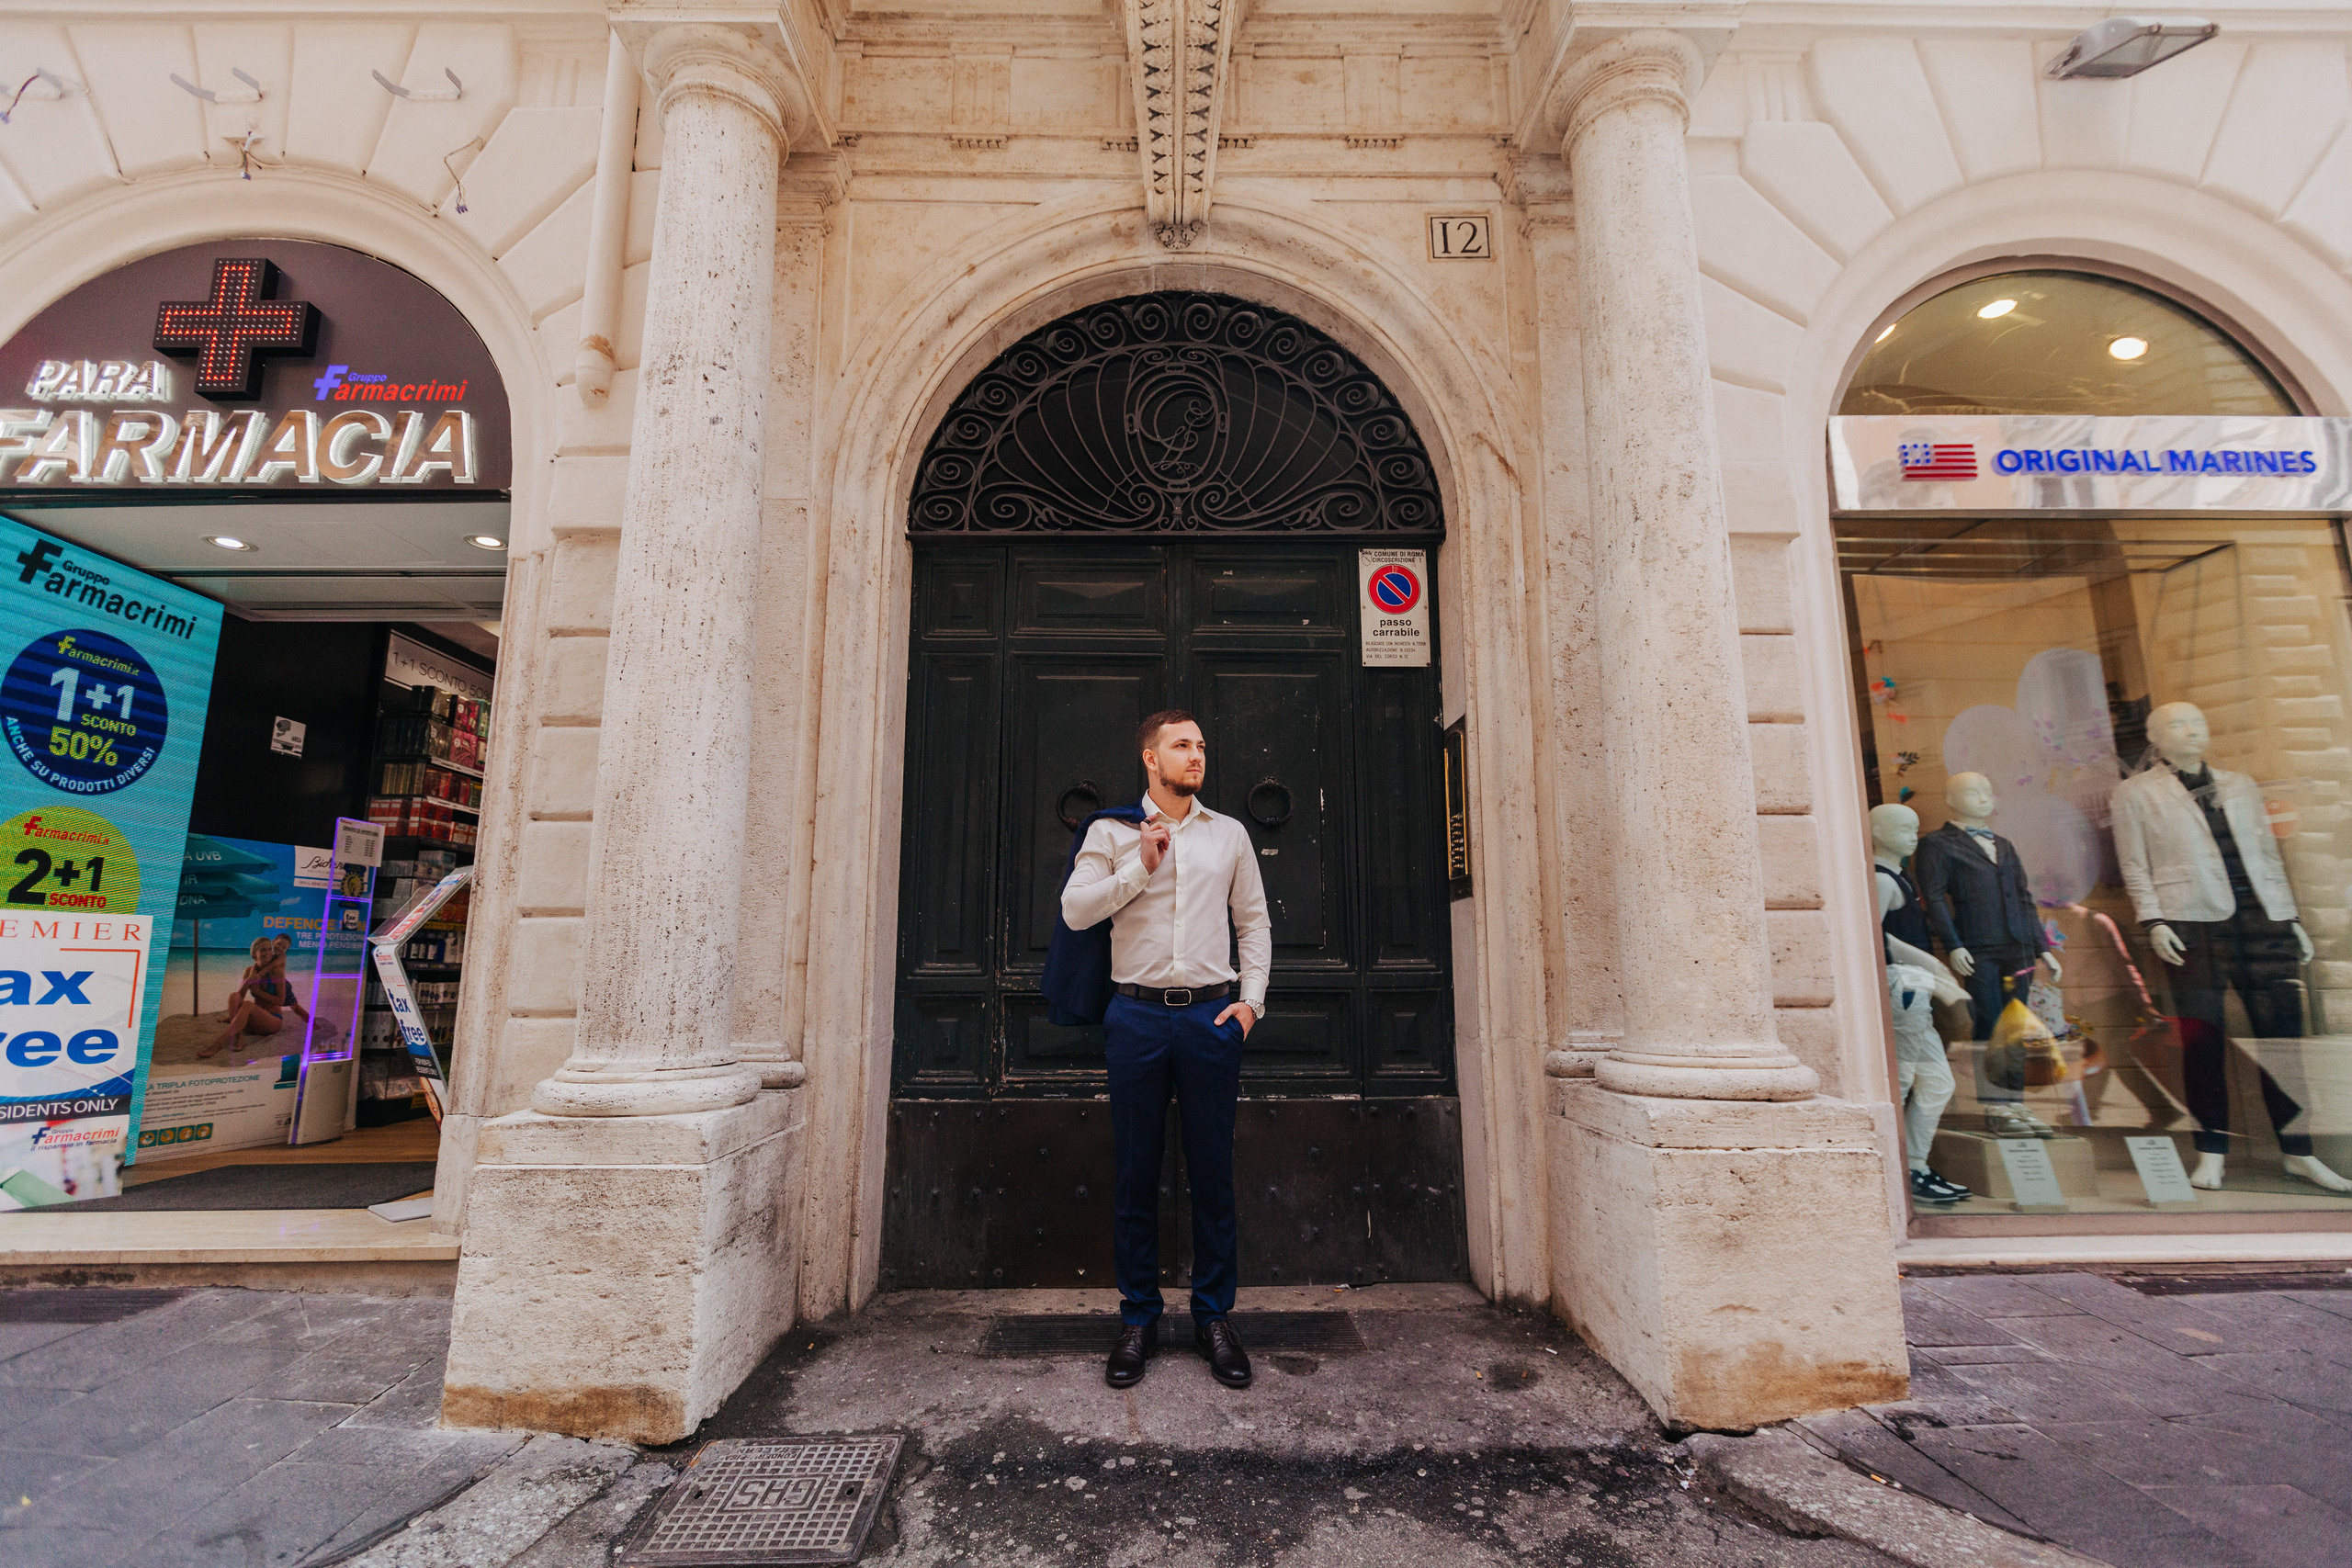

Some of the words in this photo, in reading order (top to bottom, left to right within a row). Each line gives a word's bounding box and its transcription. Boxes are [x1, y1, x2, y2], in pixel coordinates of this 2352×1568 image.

[1439, 221, 1482, 254] 12
[25, 359, 171, 400] PARA
[313, 365, 468, 400] Farmacrimi
[348, 372, 387, 384] Gruppo
[1993, 449, 2162, 476] ORIGINAL
[2166, 450, 2317, 476] MARINES
[62, 559, 110, 586] Gruppo
[17, 538, 198, 639] Farmacrimi
[1373, 628, 1420, 637] carrabile
[1380, 619, 1412, 628] passo
[393, 651, 414, 671] 1+1
[419, 662, 466, 692] SCONTO
[51, 667, 135, 722] 1+1
[81, 713, 137, 737] SCONTO
[6, 716, 35, 761] ANCHE
[31, 760, 51, 776] SU
[50, 773, 115, 792] PRODOTTI
[117, 747, 155, 784] DIVERSI
[49, 726, 119, 766] 50%
[196, 851, 221, 861] UVB
[7, 848, 105, 905] 2+1
[185, 874, 198, 884] IR
[49, 893, 107, 908] SCONTO
[179, 895, 207, 906] DNA
[263, 916, 335, 931] DEFENCE
[388, 988, 411, 1012] tax
[400, 1019, 425, 1044] free
[157, 1078, 186, 1090] TRIPLA
[188, 1074, 260, 1087] FOTOPROTEZIONE
[74, 1099, 119, 1114] ONLY
[32, 1126, 120, 1145] Farmacrimi
[38, 1142, 74, 1151] risparmio
[85, 1137, 117, 1146] farmacia
[729, 1478, 817, 1507] GAS
